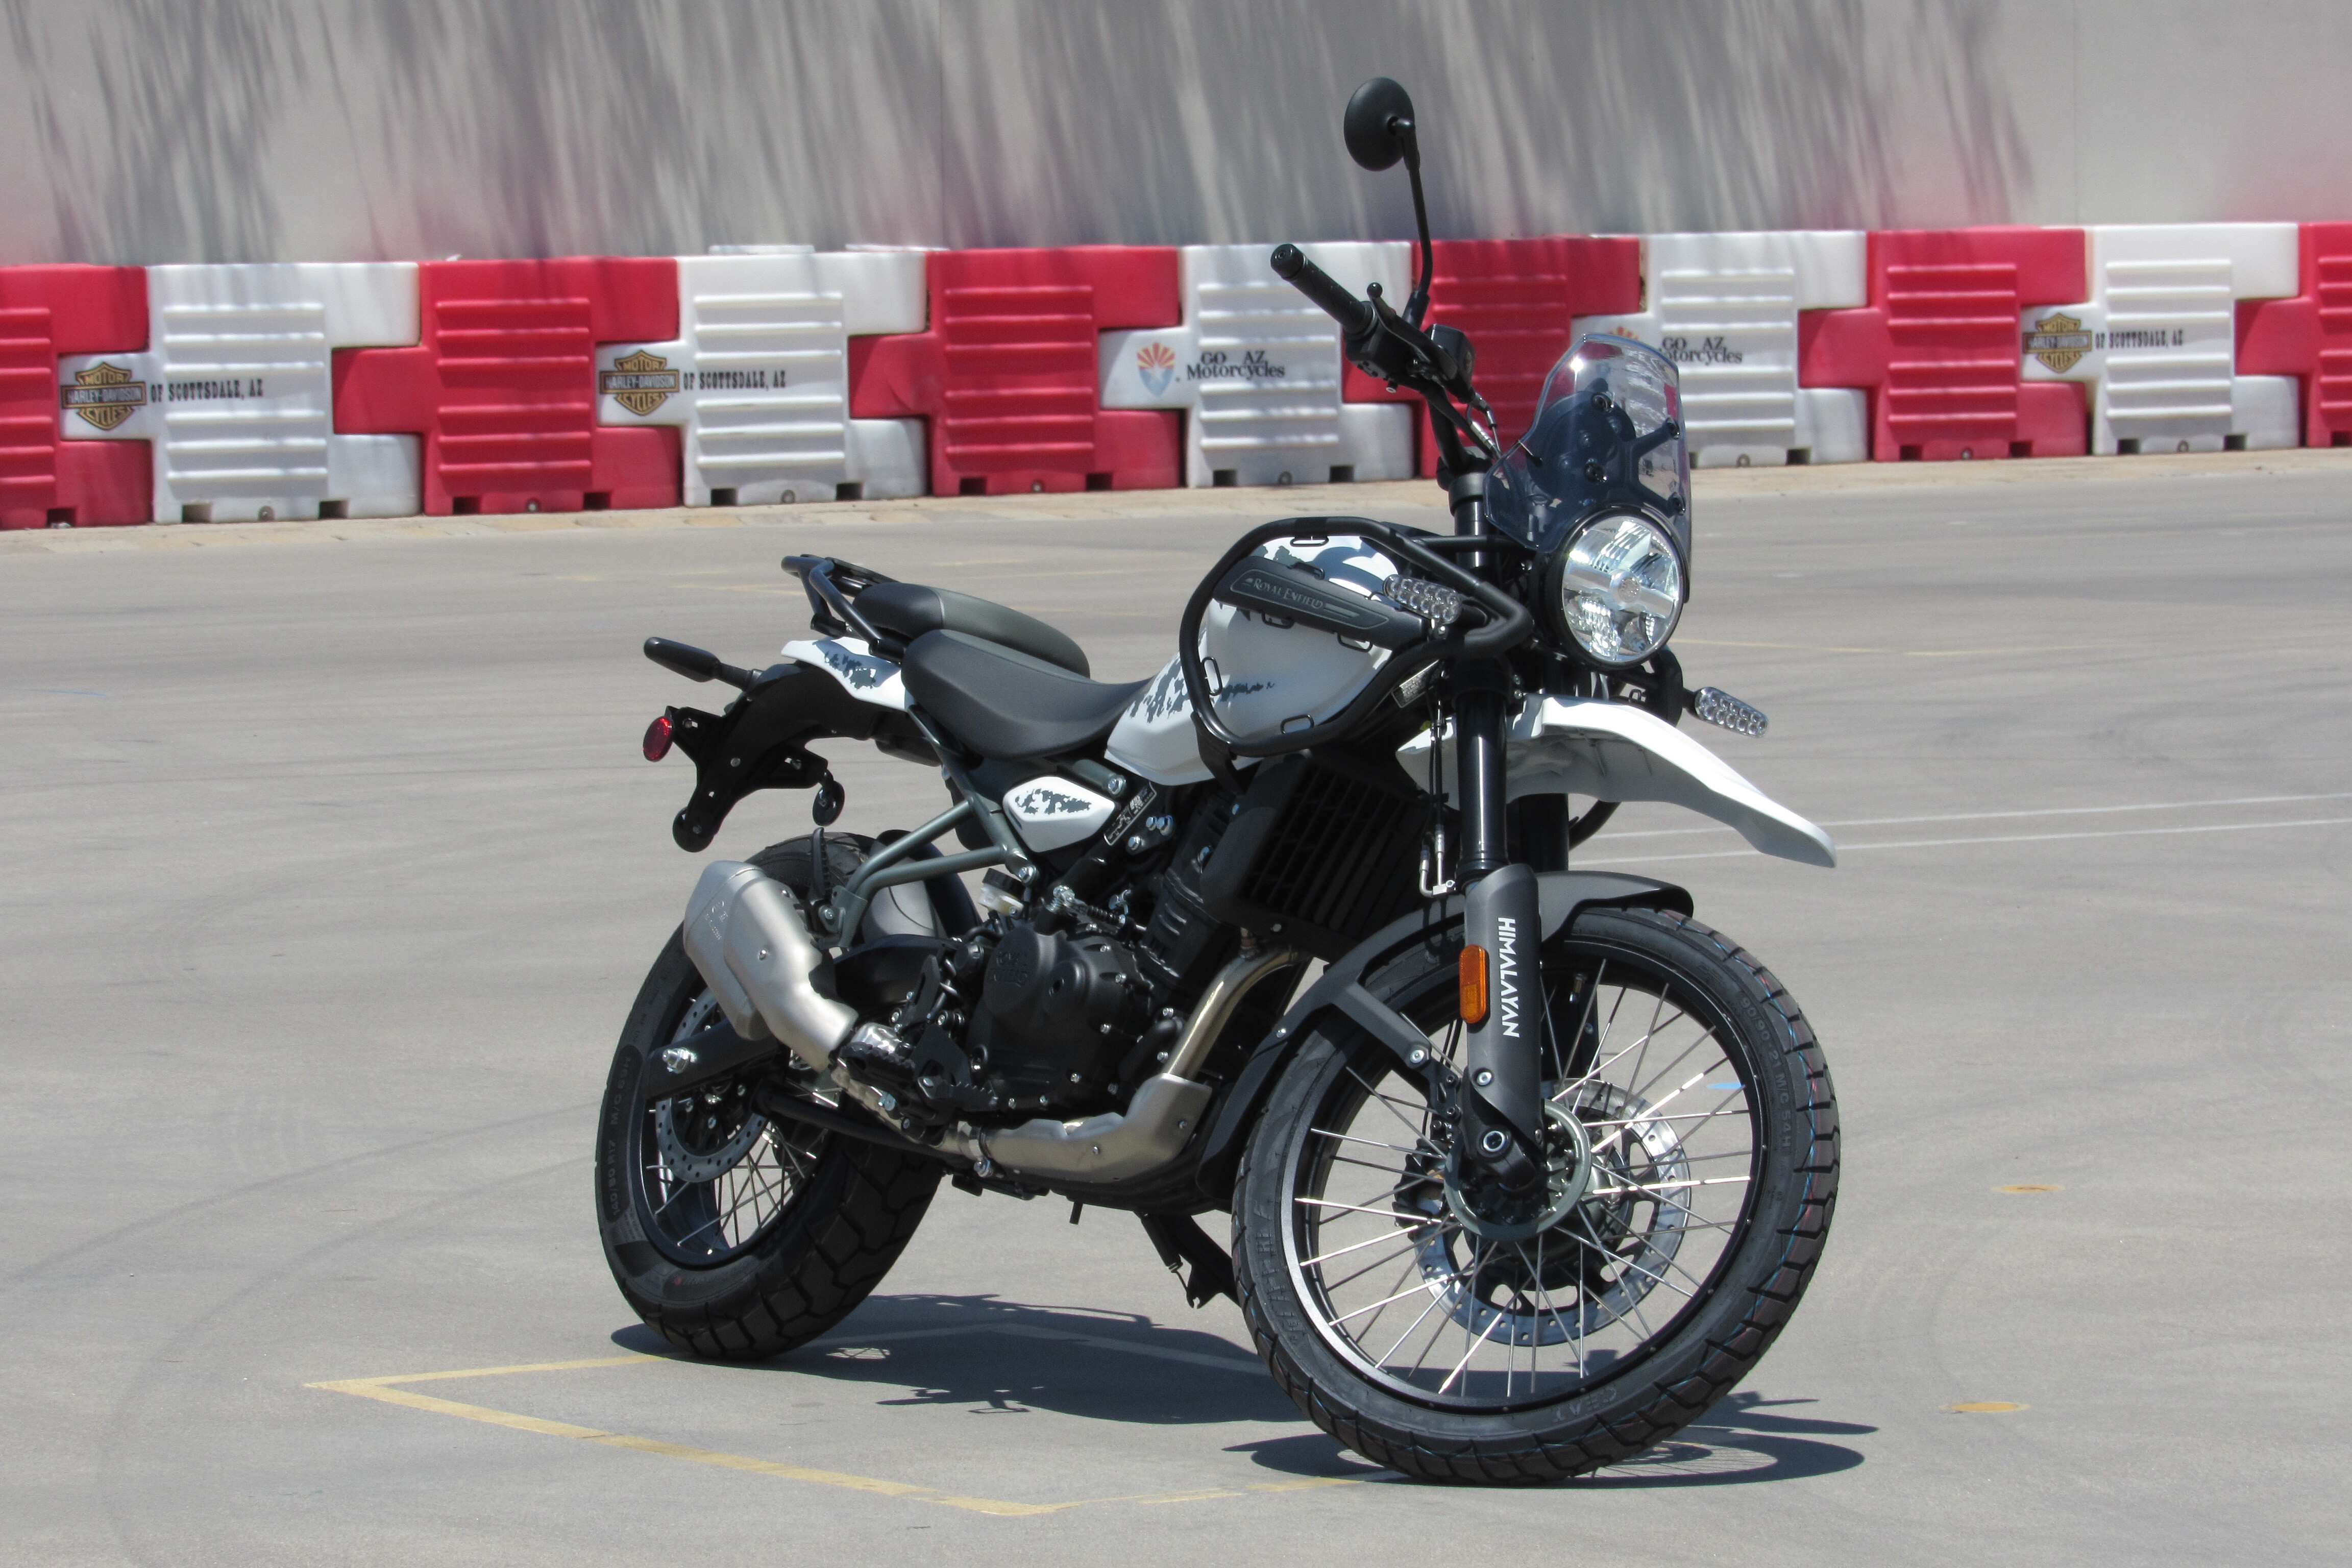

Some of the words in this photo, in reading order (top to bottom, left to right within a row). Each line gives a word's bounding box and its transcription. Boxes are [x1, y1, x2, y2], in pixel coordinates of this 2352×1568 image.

[1663, 336, 1687, 351] GO
[1703, 336, 1724, 351] AZ
[2095, 333, 2105, 350] OF
[2109, 330, 2168, 349] SCOTTSDALE,
[622, 359, 661, 372] MOTOR
[1201, 351, 1227, 365] GO
[1243, 350, 1265, 365] AZ
[1659, 347, 1742, 366] otorcycles
[84, 371, 126, 385] MOTOR
[683, 372, 695, 390] OF
[699, 371, 769, 391] SCOTTSDALE,
[773, 370, 786, 388] AZ
[1187, 360, 1285, 381] Motorcycles
[151, 384, 163, 403] OF
[168, 380, 245, 402] SCOTTSDALE,
[250, 378, 264, 397] AZ
[622, 393, 663, 411] CYCLES
[85, 407, 128, 424] CYCLES
[1253, 578, 1282, 596] ROYAL
[1283, 587, 1324, 609] ENFIELD
[1498, 917, 1520, 1038] HIMALAYAN
[1739, 996, 1771, 1042] 90/90
[1769, 1049, 1781, 1069] 21
[1775, 1073, 1790, 1105] M/C
[610, 1094, 622, 1125] M/C
[1781, 1110, 1792, 1148] 54H
[1552, 1385, 1618, 1423] CEAT
